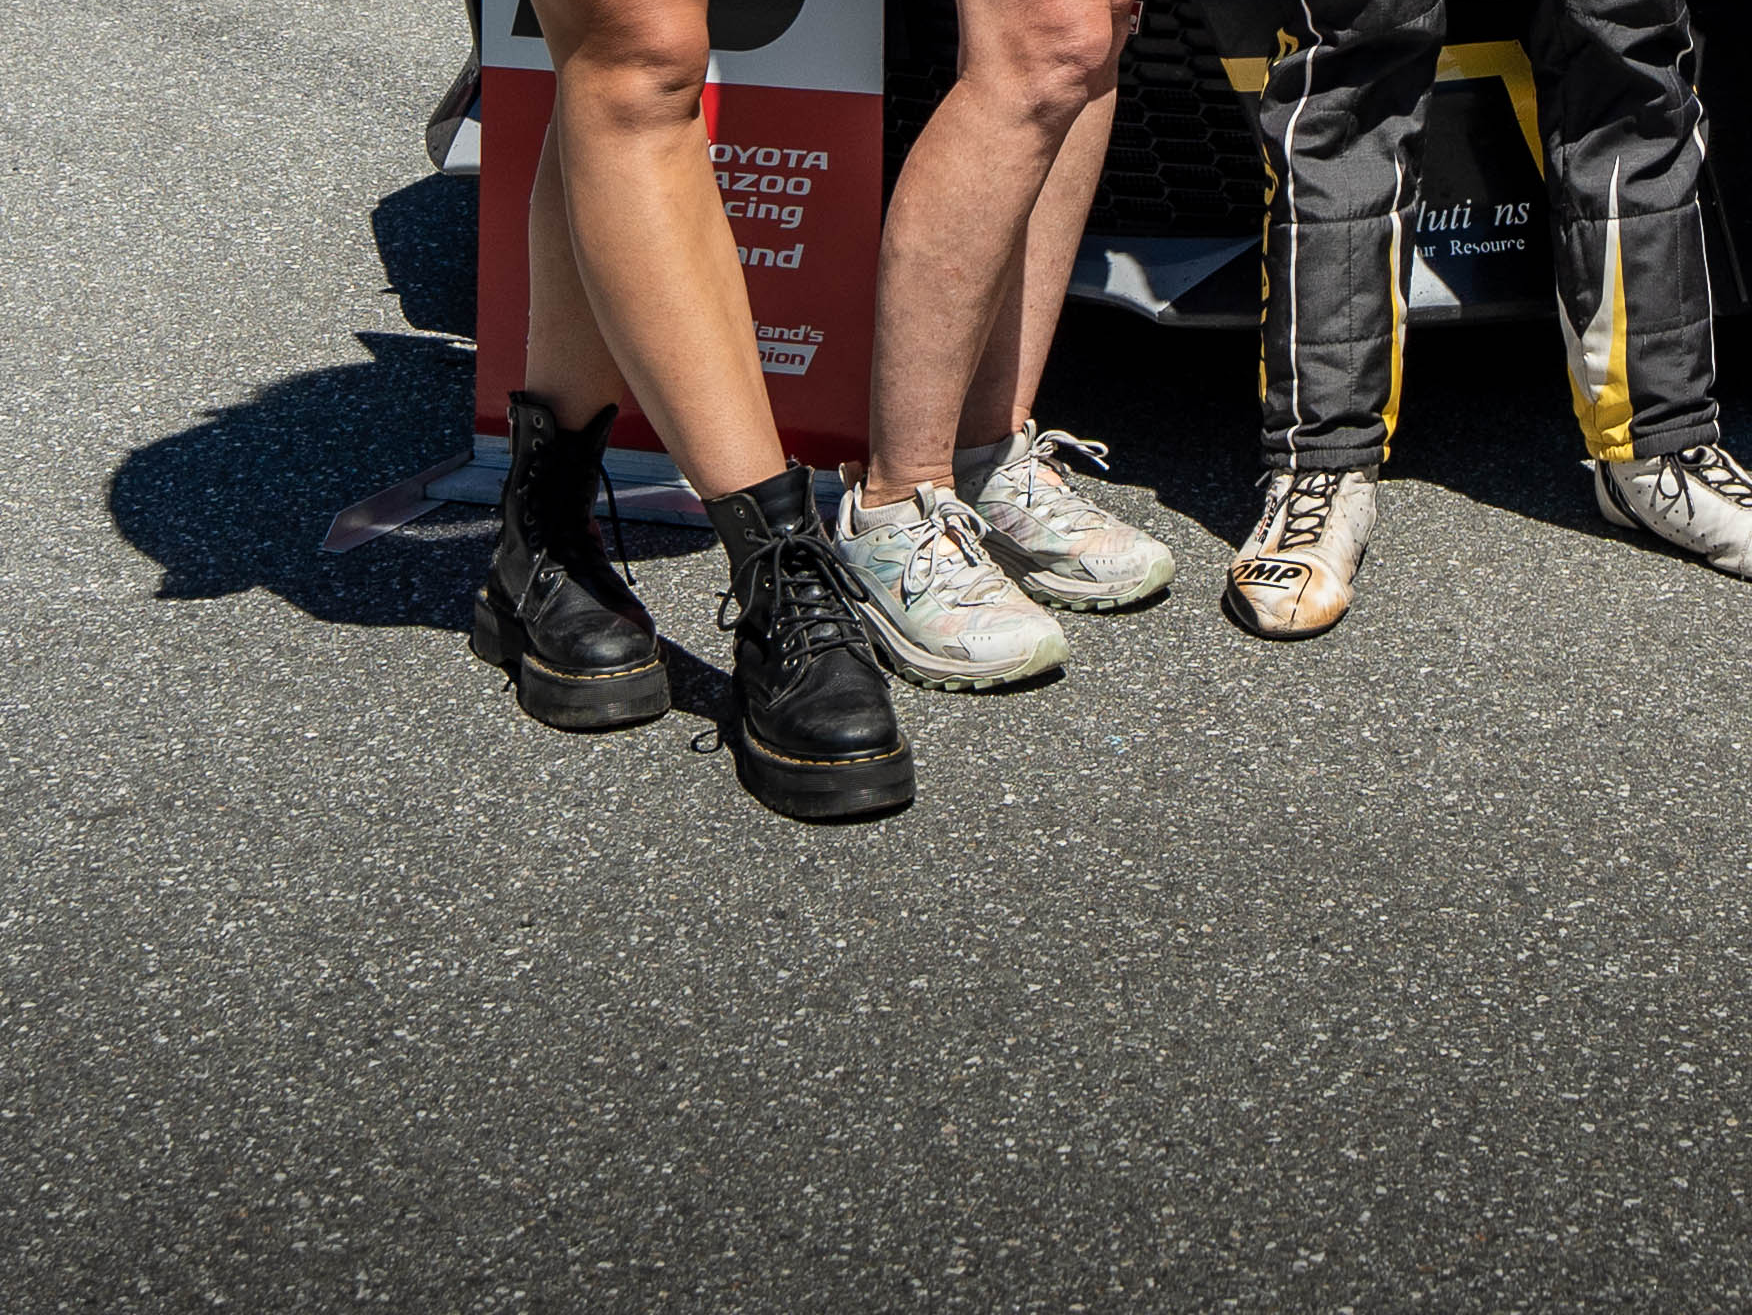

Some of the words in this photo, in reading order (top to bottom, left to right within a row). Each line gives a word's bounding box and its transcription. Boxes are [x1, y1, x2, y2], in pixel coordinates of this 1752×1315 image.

[705, 141, 828, 171] OYOTA
[711, 171, 813, 197] AZOO
[722, 198, 804, 229] cing
[752, 322, 825, 344] land's
